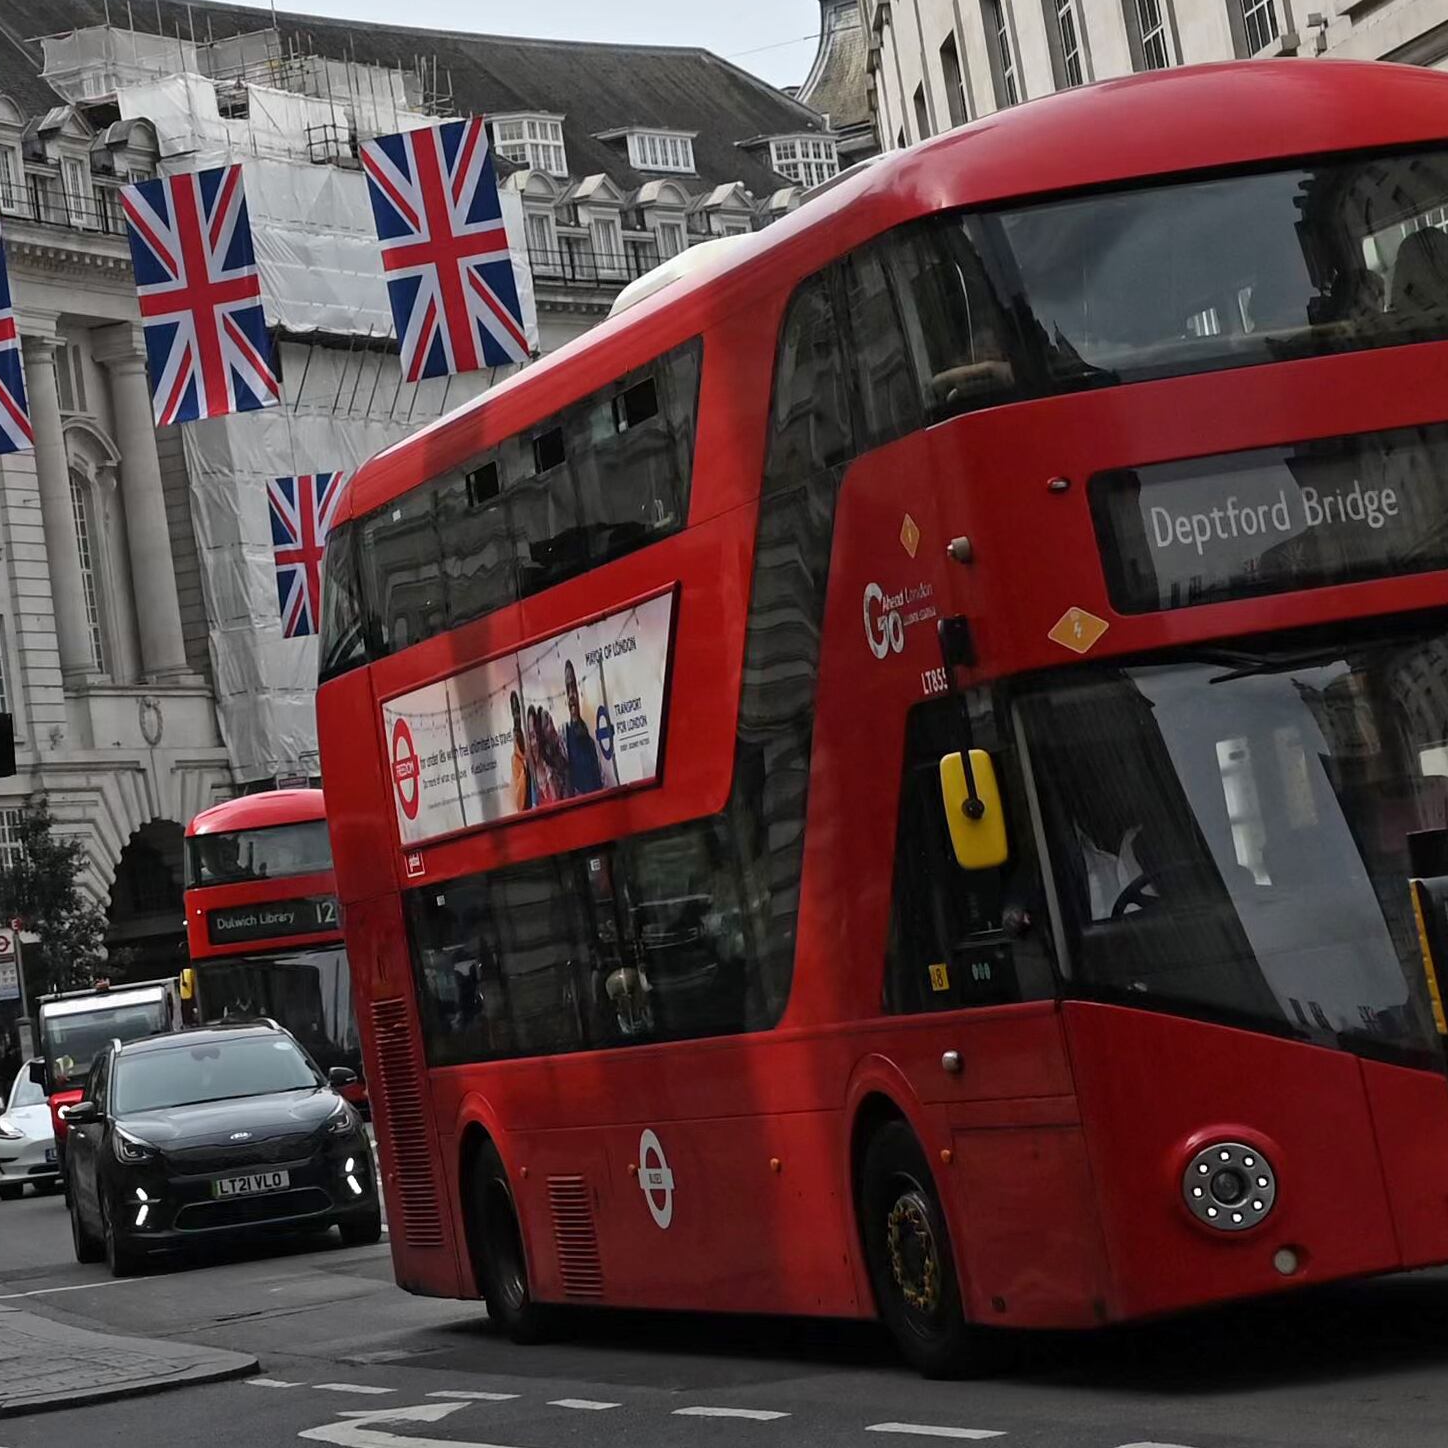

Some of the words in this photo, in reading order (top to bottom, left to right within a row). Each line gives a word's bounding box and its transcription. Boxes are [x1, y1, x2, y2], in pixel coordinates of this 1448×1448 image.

[1151, 490, 1291, 556] Deptford
[1301, 480, 1400, 528] Bridge
[882, 589, 904, 613] Ahead
[904, 581, 933, 604] London
[612, 636, 637, 656] LONDON
[614, 698, 642, 716] TRANSPORT
[216, 914, 257, 930] Dulwich
[259, 911, 295, 925] Library
[316, 902, 337, 924] 12
[219, 1177, 251, 1194] LT21
[254, 1173, 281, 1190] VLO
